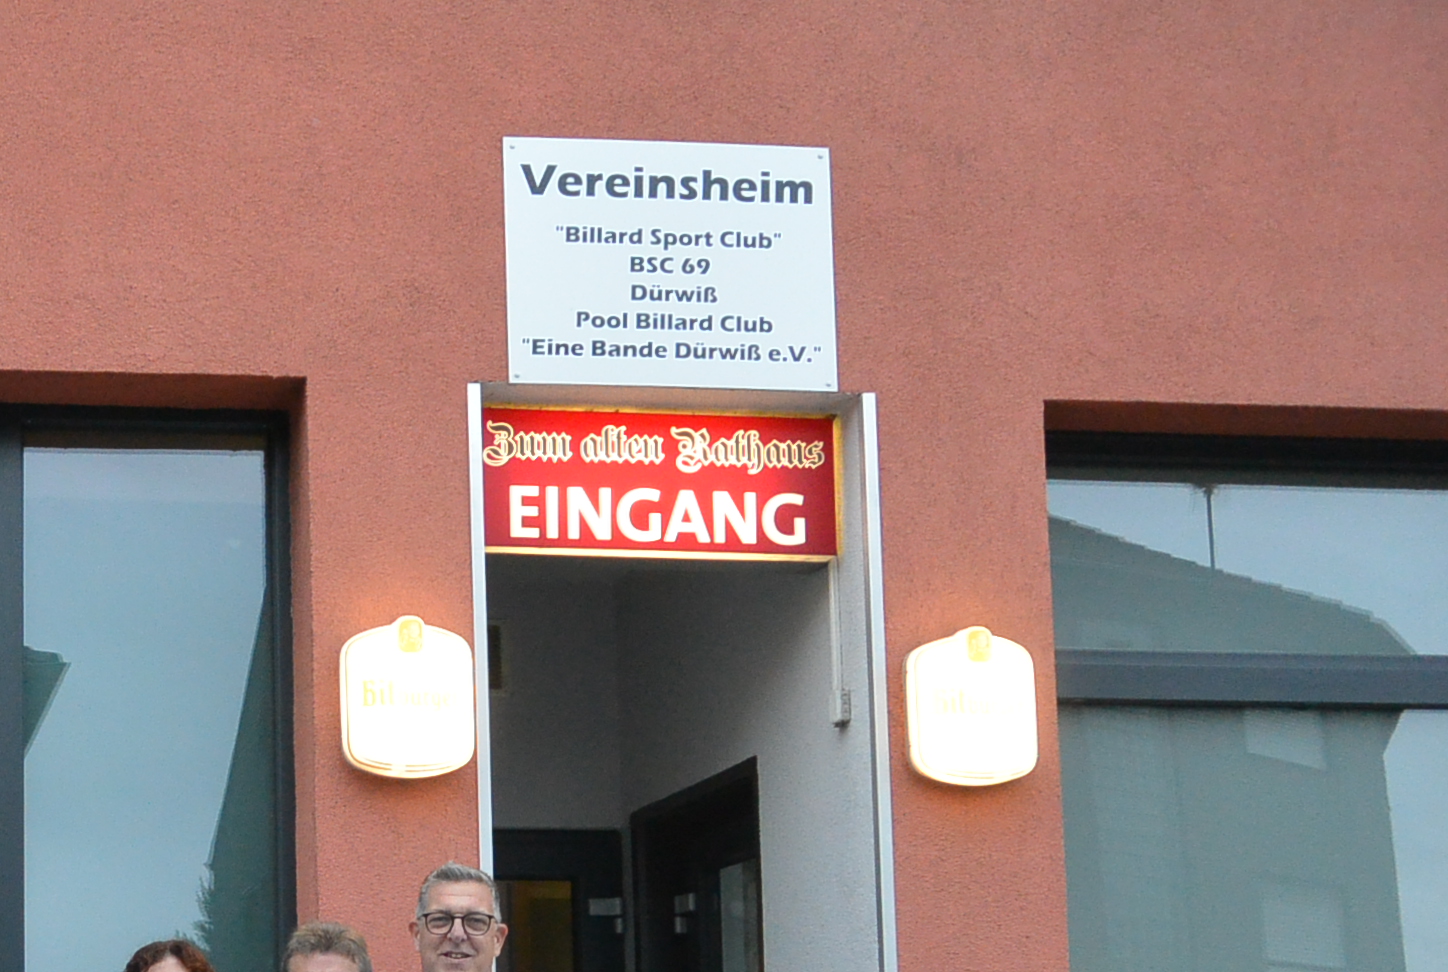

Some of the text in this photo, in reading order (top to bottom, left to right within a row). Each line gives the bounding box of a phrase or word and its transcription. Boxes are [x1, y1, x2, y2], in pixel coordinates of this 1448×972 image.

[520, 163, 814, 204] Vereinsheim
[555, 225, 782, 250] "Billard Sport Club"
[629, 256, 711, 274] BSC 69
[630, 284, 718, 303] Dürwiß
[575, 311, 774, 333] Pool Billard Club
[522, 338, 822, 363] "Eine Bande Dürwiß e.V."
[483, 420, 826, 475] Zum alten Rathaus
[508, 484, 807, 546] EINGANG
